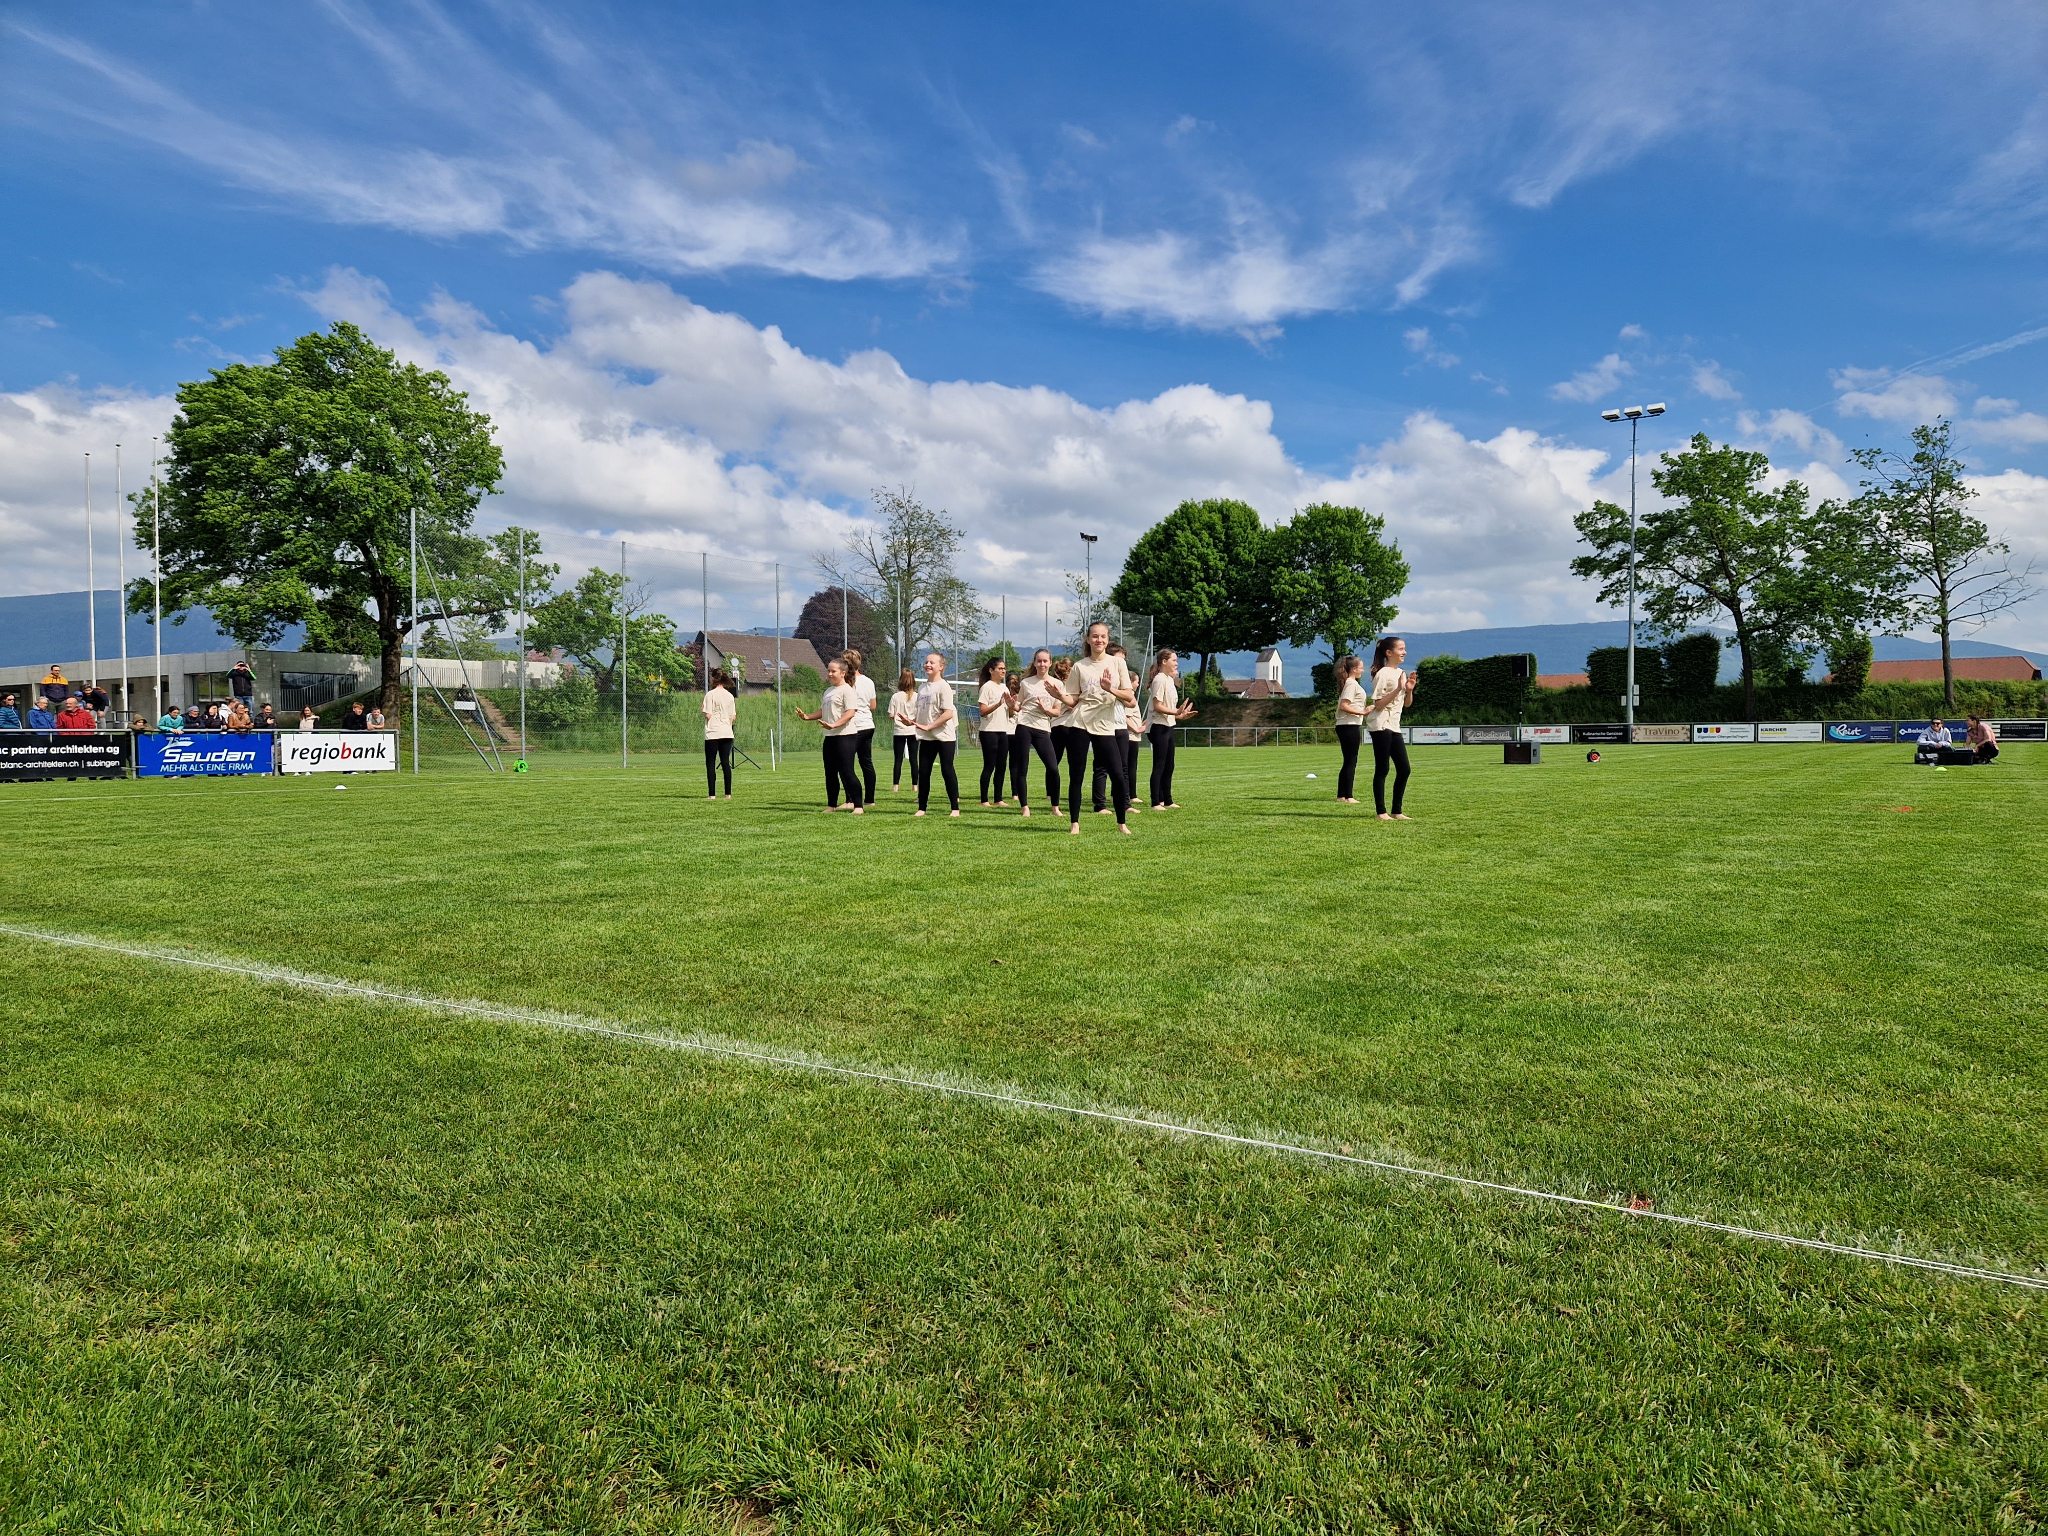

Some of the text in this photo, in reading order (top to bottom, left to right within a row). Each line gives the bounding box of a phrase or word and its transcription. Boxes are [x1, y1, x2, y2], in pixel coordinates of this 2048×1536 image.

[1643, 728, 1680, 736] TraVino
[11, 745, 48, 756] partner
[49, 744, 105, 754] architekten
[106, 746, 120, 755] ag
[162, 748, 256, 763] Saudan
[290, 742, 387, 765] regiobank
[86, 759, 120, 768] subingen
[159, 762, 254, 773] MEHR ALS EINE FIRMA
